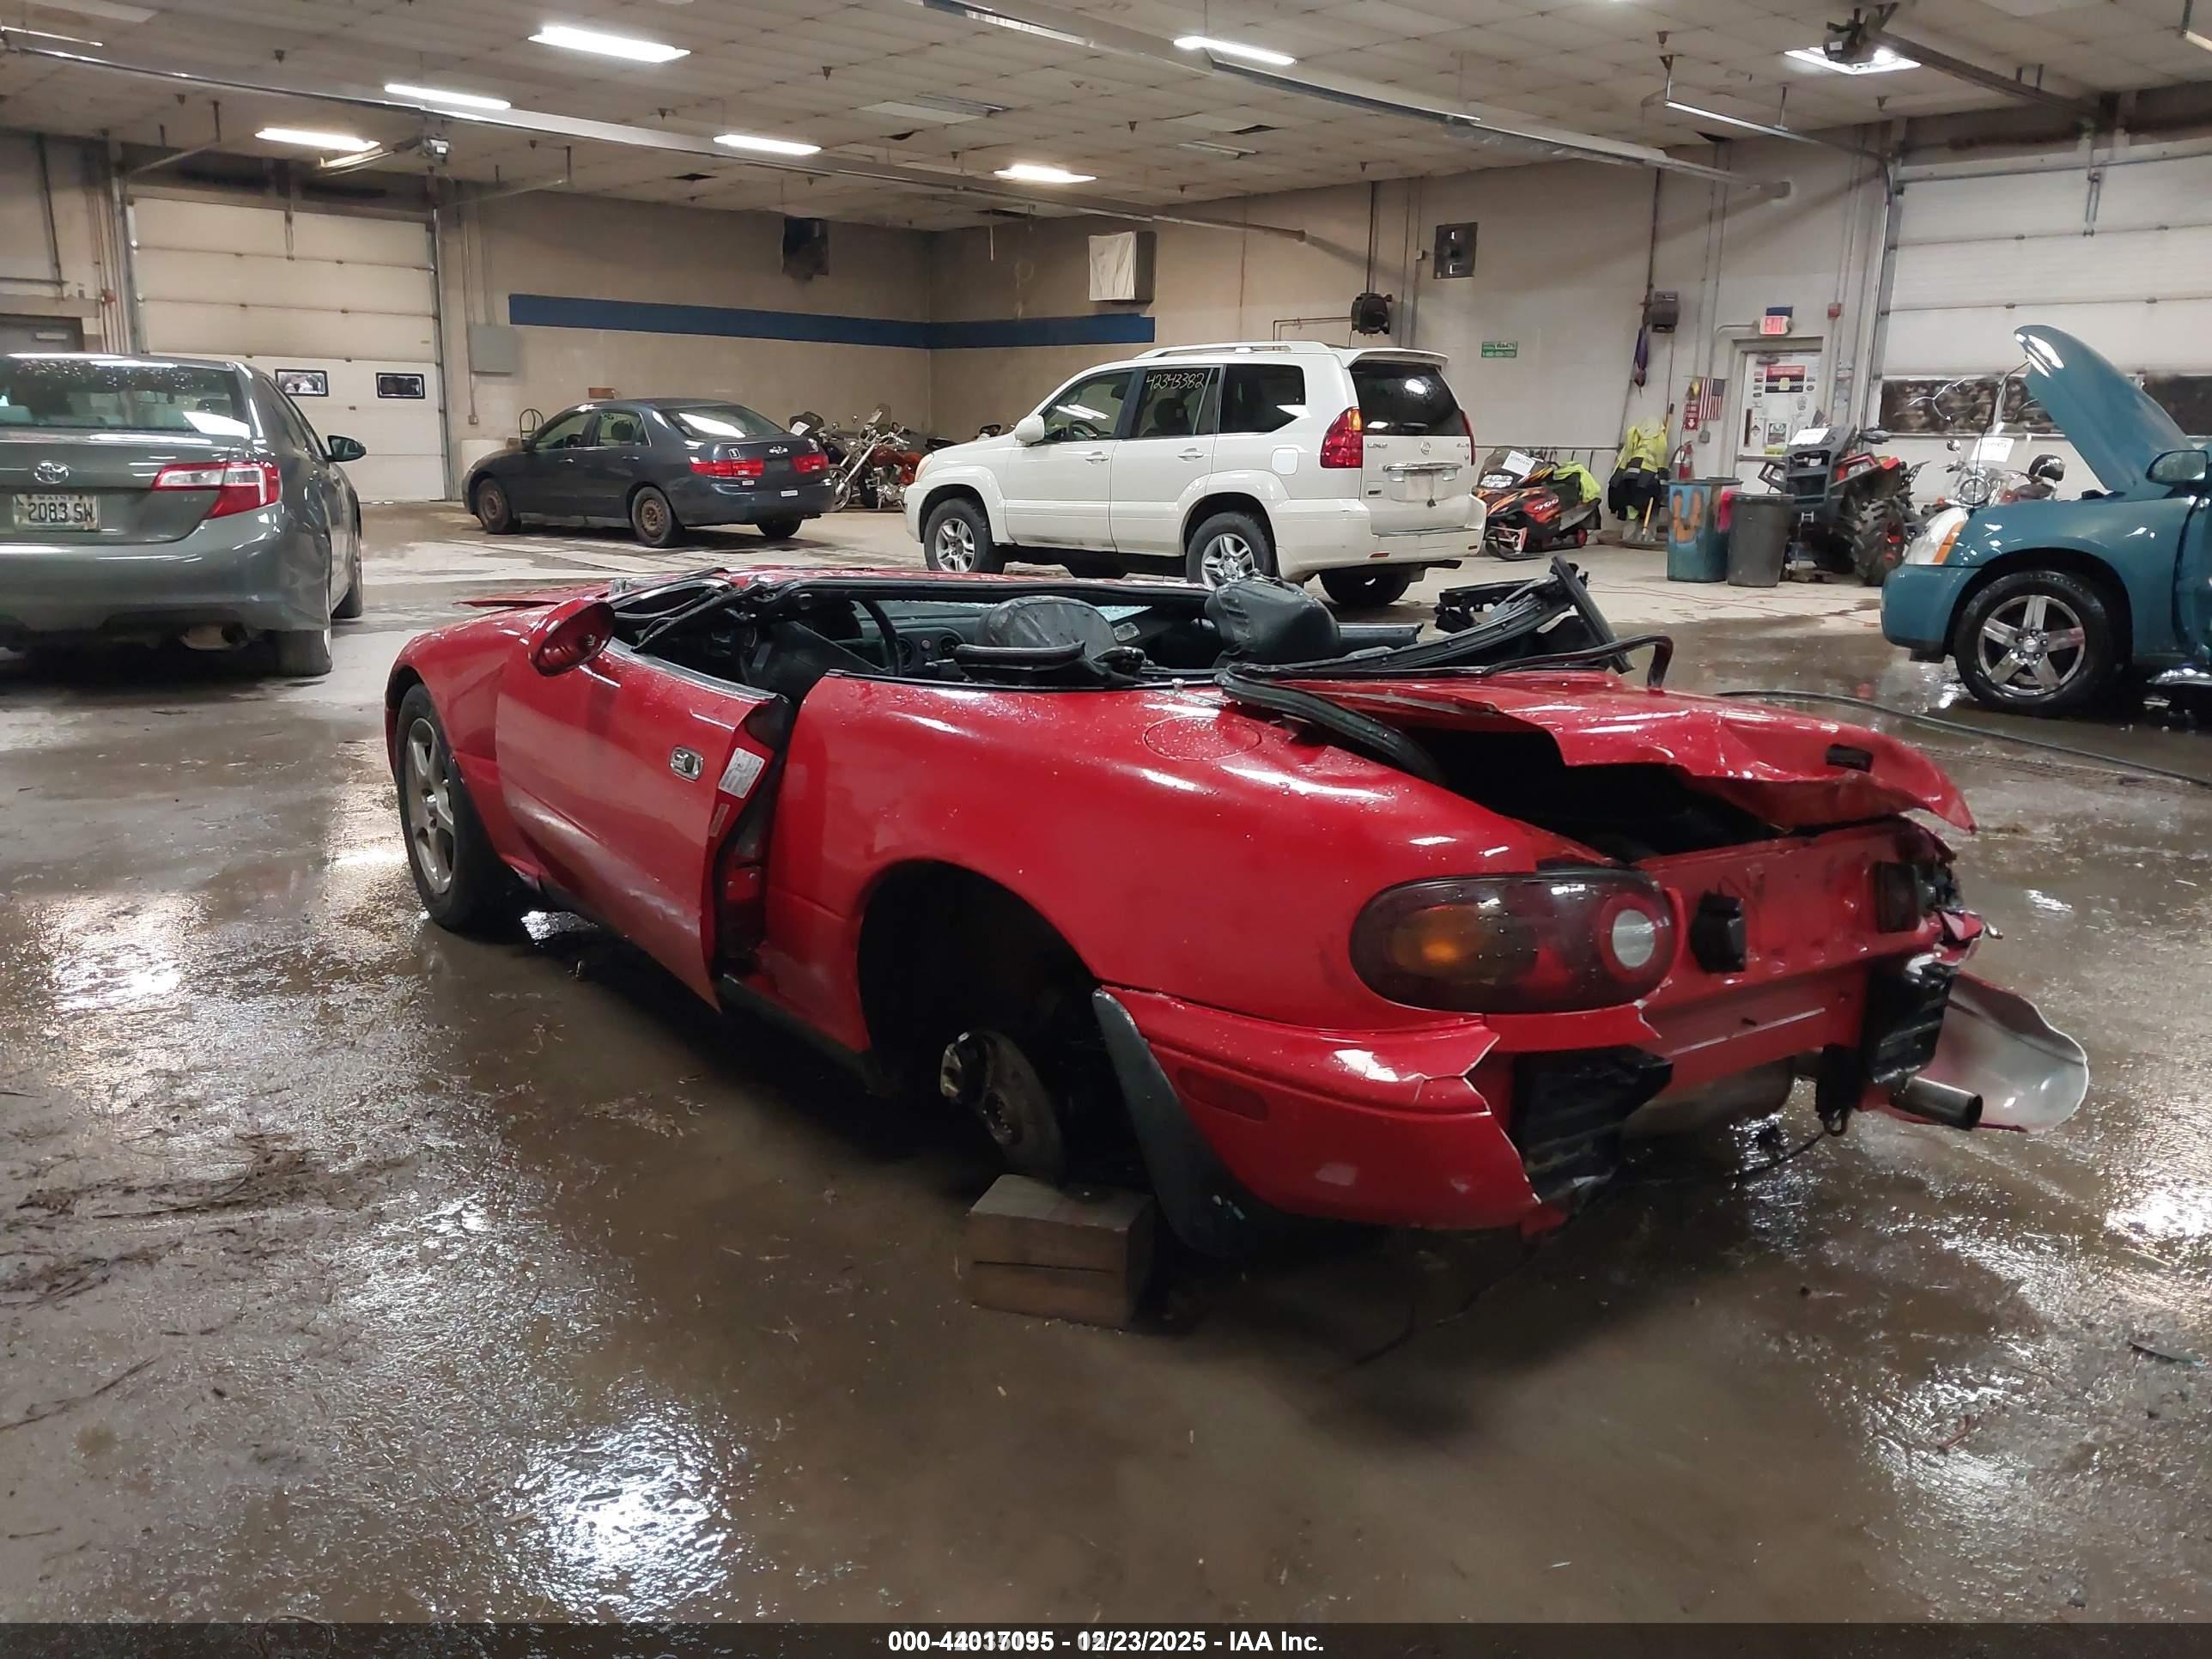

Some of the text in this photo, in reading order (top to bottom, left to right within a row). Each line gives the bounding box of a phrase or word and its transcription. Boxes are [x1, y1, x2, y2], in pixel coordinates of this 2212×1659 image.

[1146, 373, 1205, 390] 42343382
[28, 502, 94, 523] 2083 SW
